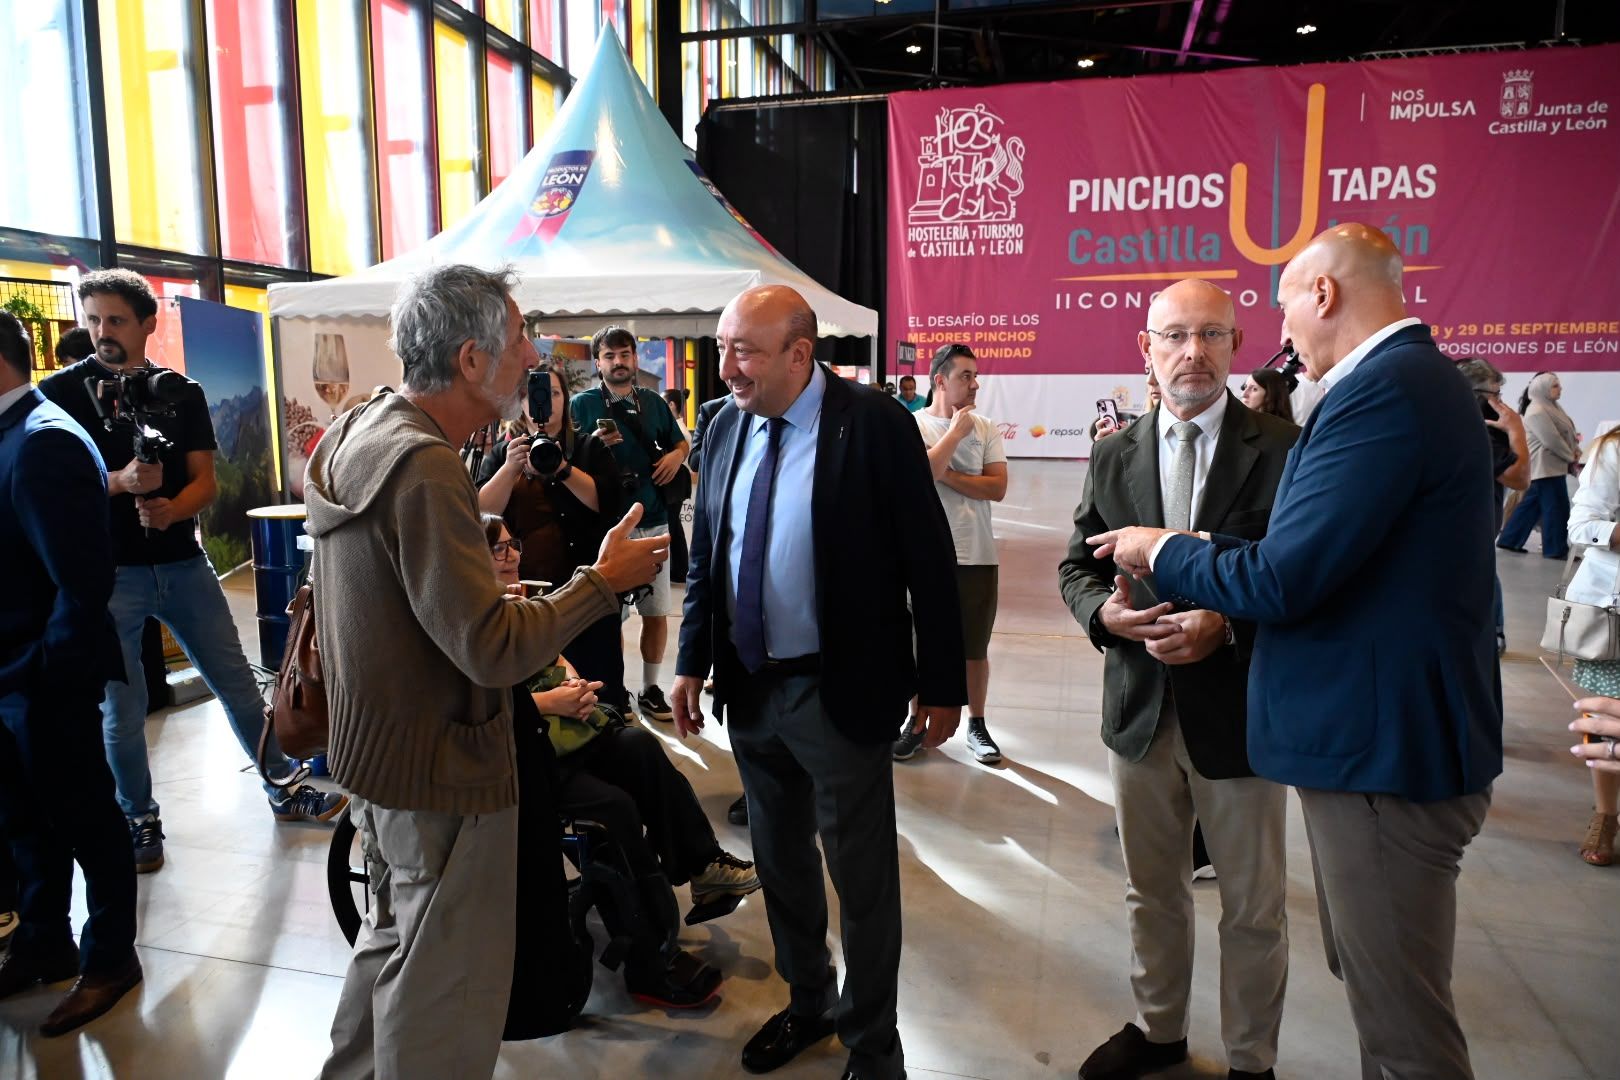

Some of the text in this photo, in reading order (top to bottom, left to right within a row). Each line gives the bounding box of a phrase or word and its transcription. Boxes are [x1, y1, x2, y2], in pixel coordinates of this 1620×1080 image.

[1390, 89, 1425, 102] NOS
[1535, 100, 1608, 117] Junta de
[1488, 116, 1608, 135] Castilla y León
[542, 170, 584, 186] LEÓN
[1068, 173, 1225, 213] PINCHOS
[1328, 164, 1438, 202] TAPAS
[908, 224, 969, 242] HOSTELERÍA
[978, 224, 1024, 240] TURISMO
[908, 238, 1024, 258] de CASTILLA y LEÓN
[1068, 224, 1221, 265] Castilla
[908, 312, 1040, 327] EL DESAFÍO DE LOS
[908, 331, 1037, 343] MEJORES PINCHOS
[1431, 321, 1619, 339] 8 y 29 DE SEPTIEMBRE
[916, 348, 925, 359] E
[975, 347, 1032, 359] MUNIDAD
[1438, 337, 1618, 355] POSICIONES DE LEÓN
[1050, 427, 1084, 436] repsol
